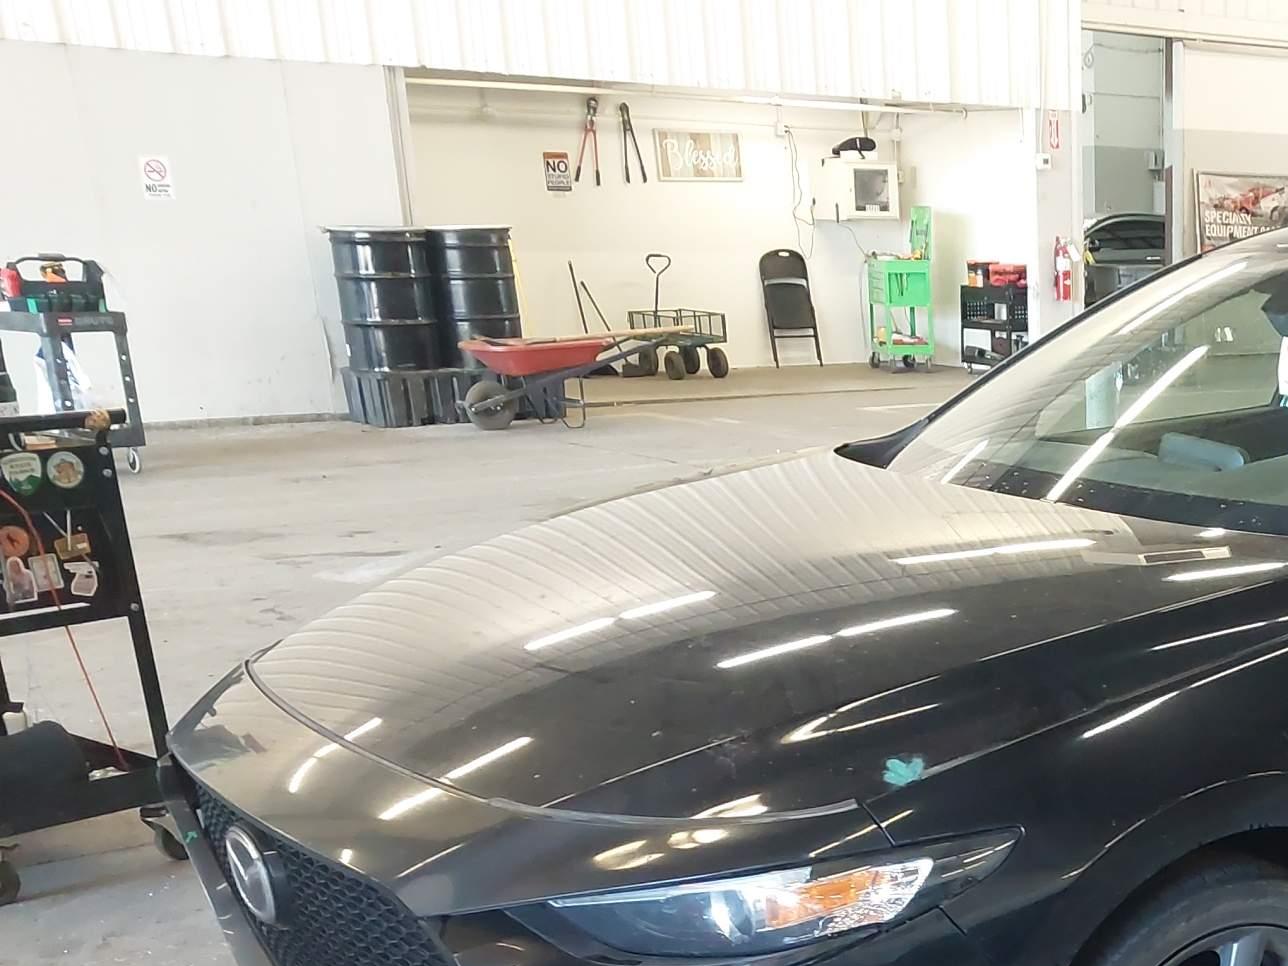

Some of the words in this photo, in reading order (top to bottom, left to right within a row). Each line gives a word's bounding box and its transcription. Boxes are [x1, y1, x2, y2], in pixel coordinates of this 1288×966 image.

[662, 139, 738, 170] Blessed
[546, 160, 568, 173] NO
[145, 183, 158, 193] NO
